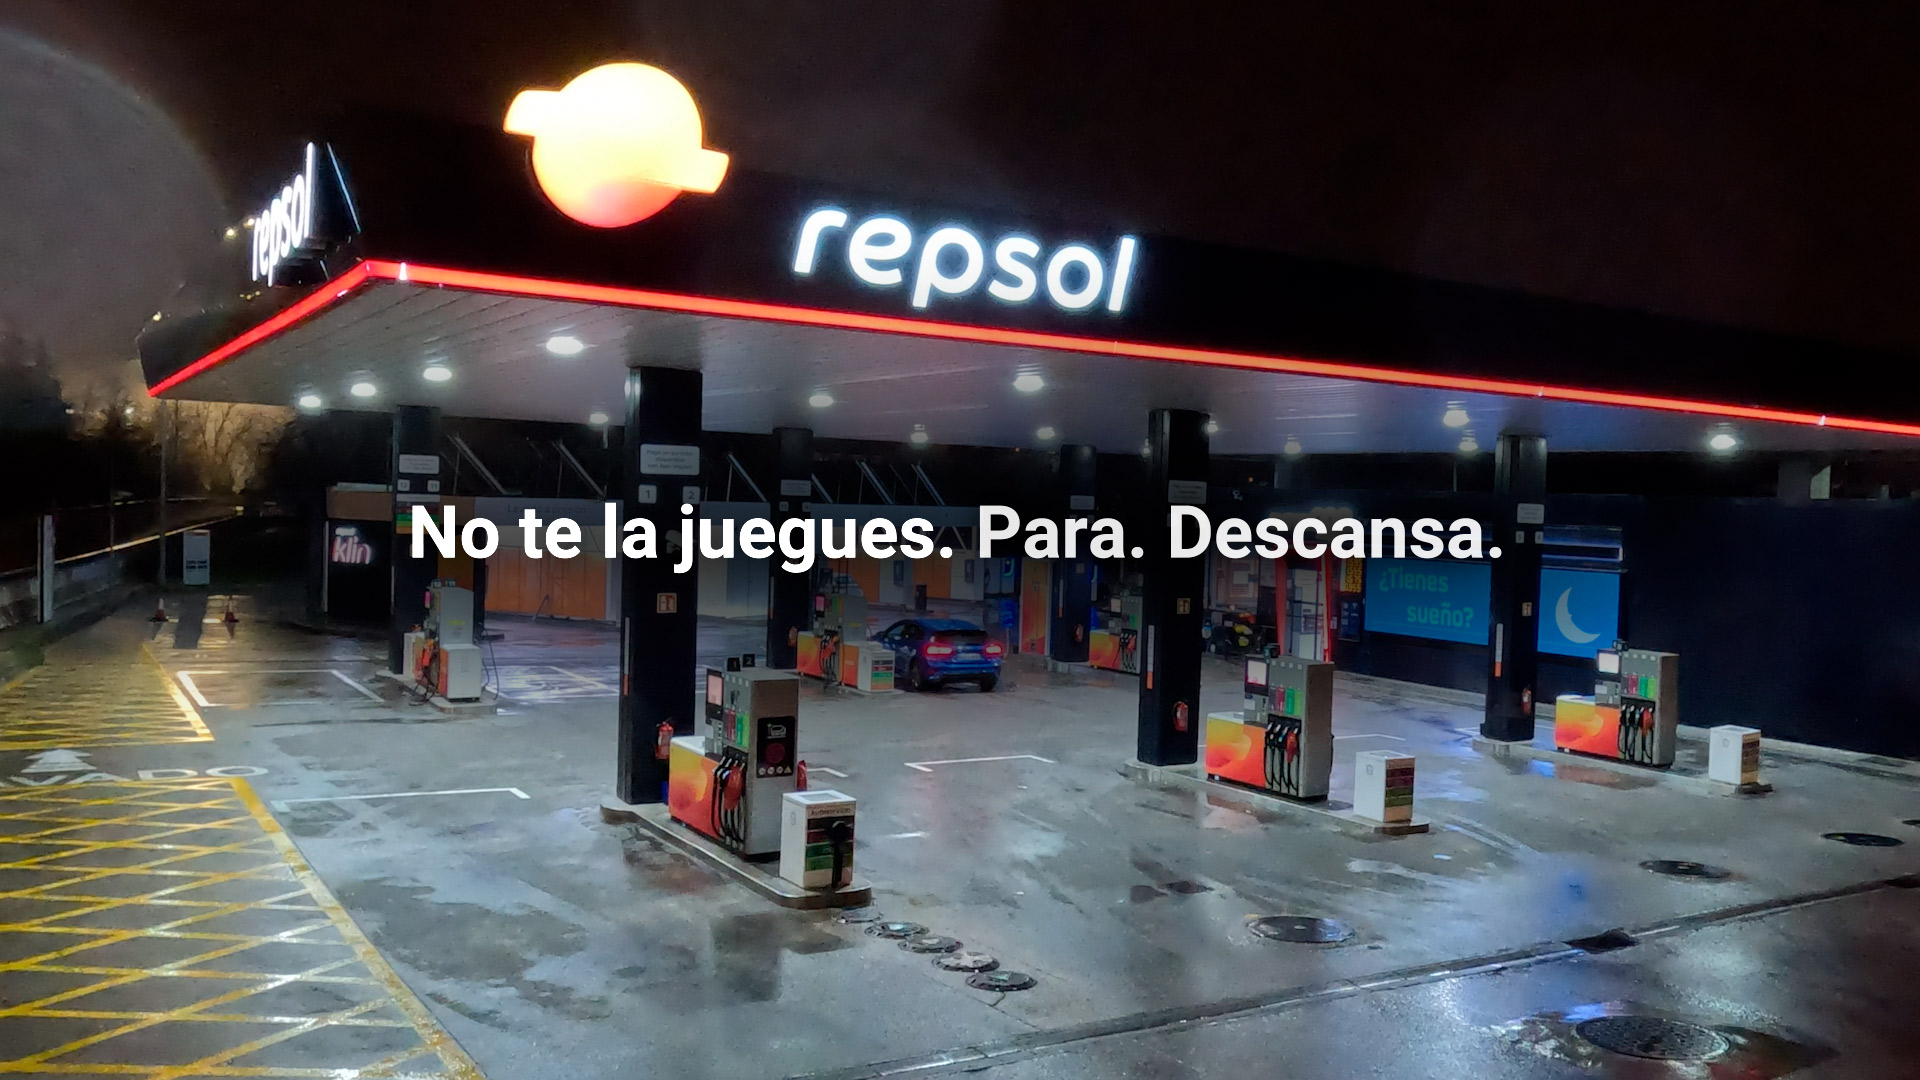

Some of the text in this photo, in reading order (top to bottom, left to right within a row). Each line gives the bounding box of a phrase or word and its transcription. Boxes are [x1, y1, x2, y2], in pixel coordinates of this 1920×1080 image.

[252, 142, 315, 287] repsol
[793, 209, 1136, 312] repsol
[645, 489, 651, 499] 1
[687, 490, 696, 500] 2
[331, 535, 370, 565] klin
[1379, 566, 1449, 593] ¿Tienes
[1407, 602, 1474, 628] sueño?
[744, 656, 754, 667] 2
[8, 765, 269, 786] VADO
